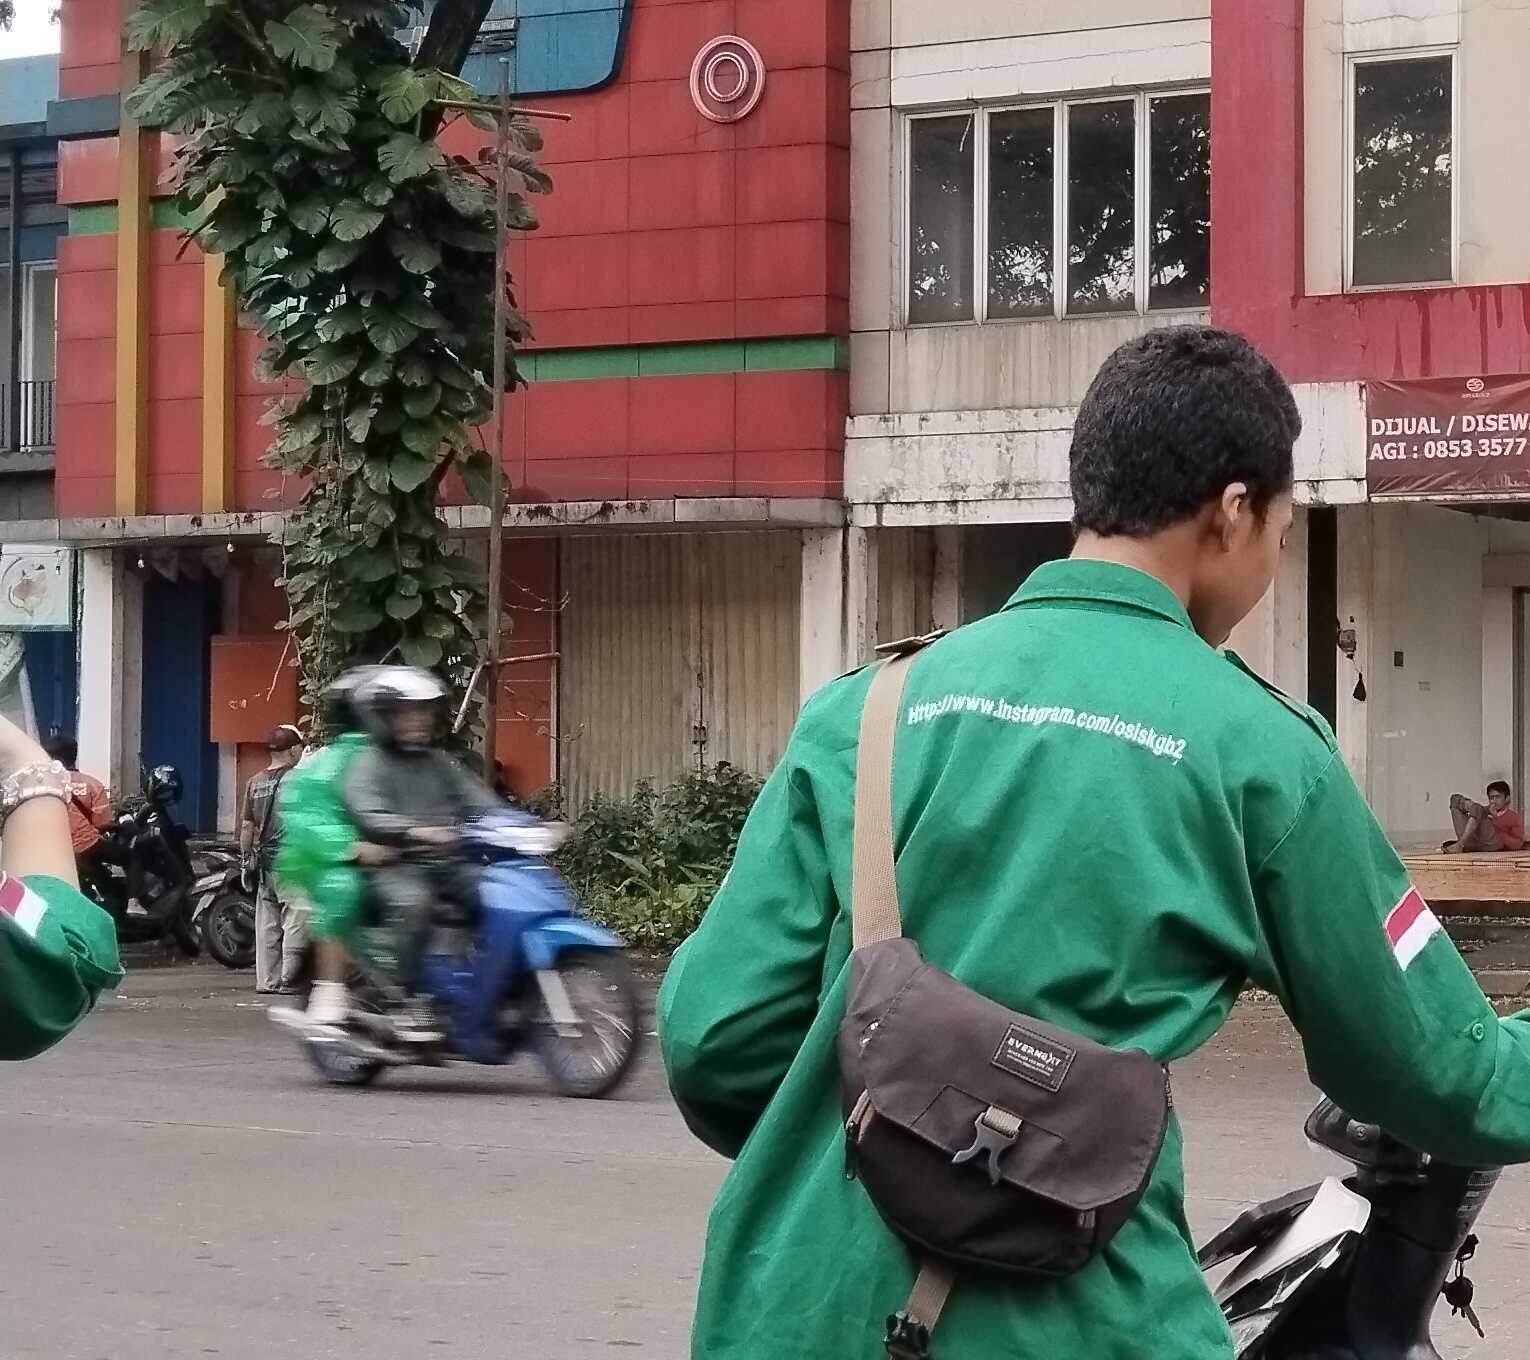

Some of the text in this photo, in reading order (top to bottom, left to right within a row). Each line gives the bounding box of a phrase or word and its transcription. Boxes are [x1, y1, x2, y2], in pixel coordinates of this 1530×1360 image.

[1371, 416, 1441, 436] DIJUAL
[1446, 416, 1455, 437] /
[1369, 442, 1407, 460] AGI
[1424, 439, 1473, 459] 0853
[1478, 437, 1527, 457] 3577
